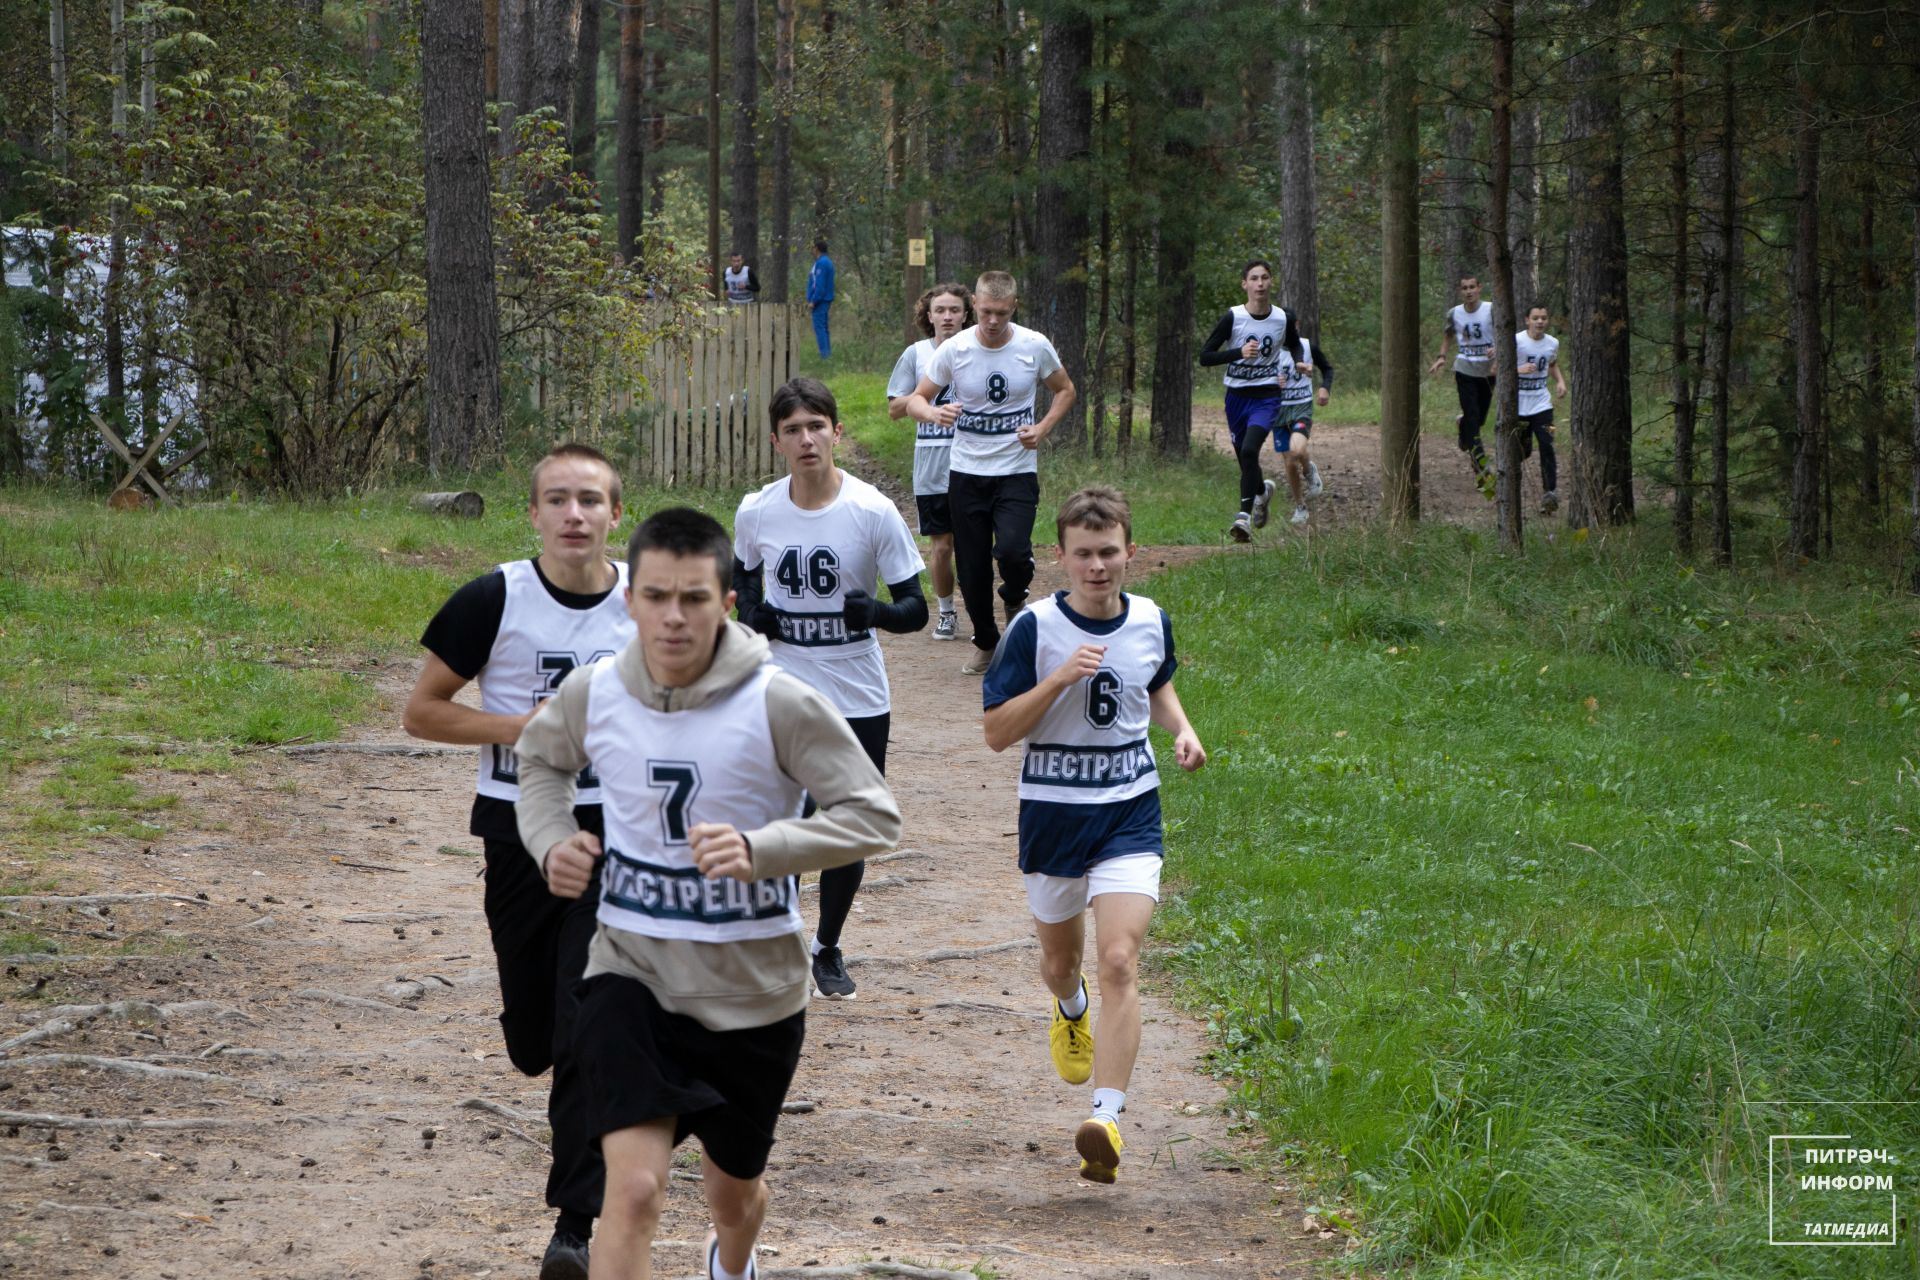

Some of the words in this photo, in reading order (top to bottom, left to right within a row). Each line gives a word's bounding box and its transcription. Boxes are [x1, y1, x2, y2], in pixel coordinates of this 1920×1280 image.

[985, 371, 1010, 407] 8
[774, 545, 840, 598] 46
[776, 615, 868, 644] СТРЕЦ
[533, 650, 616, 708] 3
[1085, 667, 1123, 730] 6
[646, 758, 702, 846] 7
